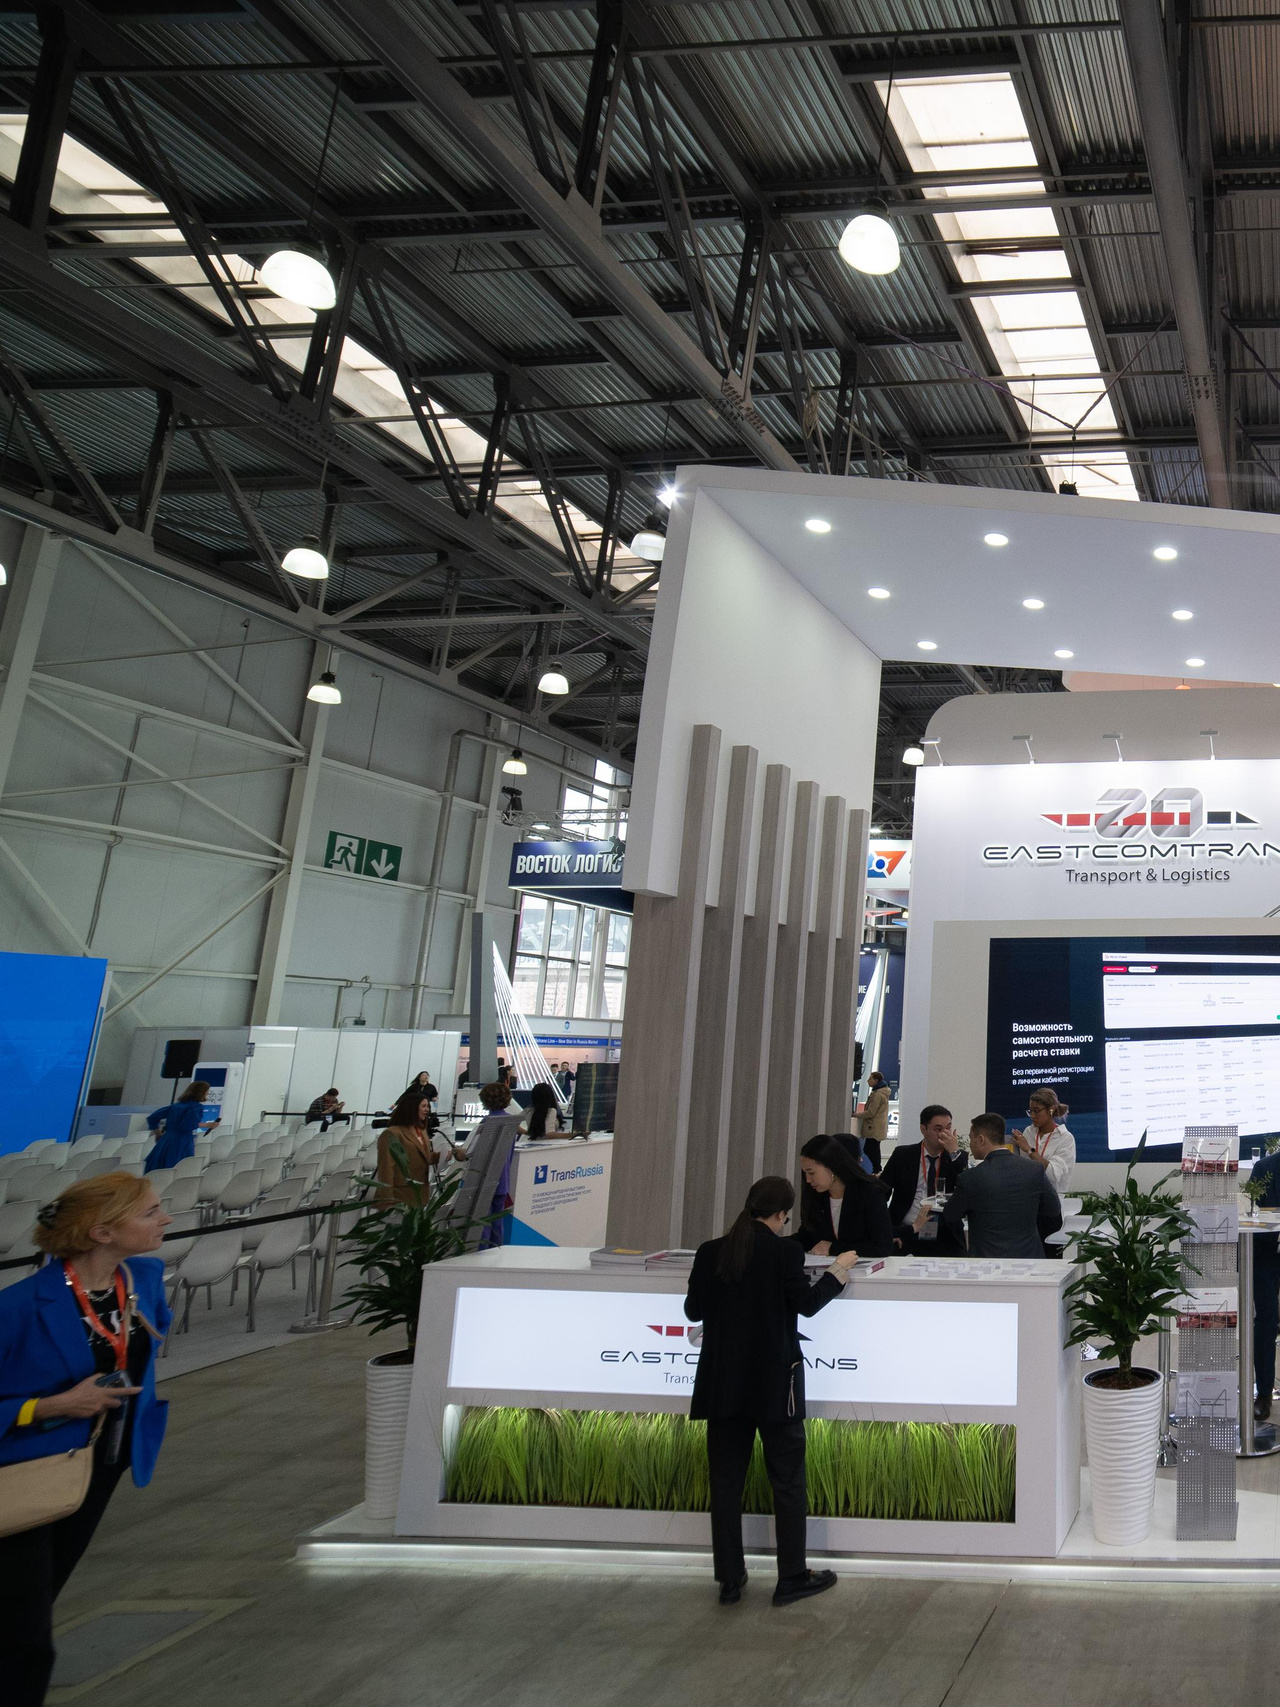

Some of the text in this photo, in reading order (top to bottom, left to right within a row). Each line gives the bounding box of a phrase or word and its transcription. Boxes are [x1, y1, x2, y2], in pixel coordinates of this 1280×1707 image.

[516, 854, 571, 874] ВОСТОК
[1065, 867, 1231, 885] Transport & Logistics
[1012, 1023, 1073, 1032] Возможность
[1012, 1034, 1093, 1045] самостоятельного
[1012, 1048, 1080, 1059] расчета ставки
[1025, 1067, 1057, 1076] первичной
[1058, 1066, 1094, 1075] регистрации
[551, 1163, 604, 1182] TransRussia
[600, 1350, 858, 1370] EASTCANS
[663, 1372, 696, 1385] Trans
